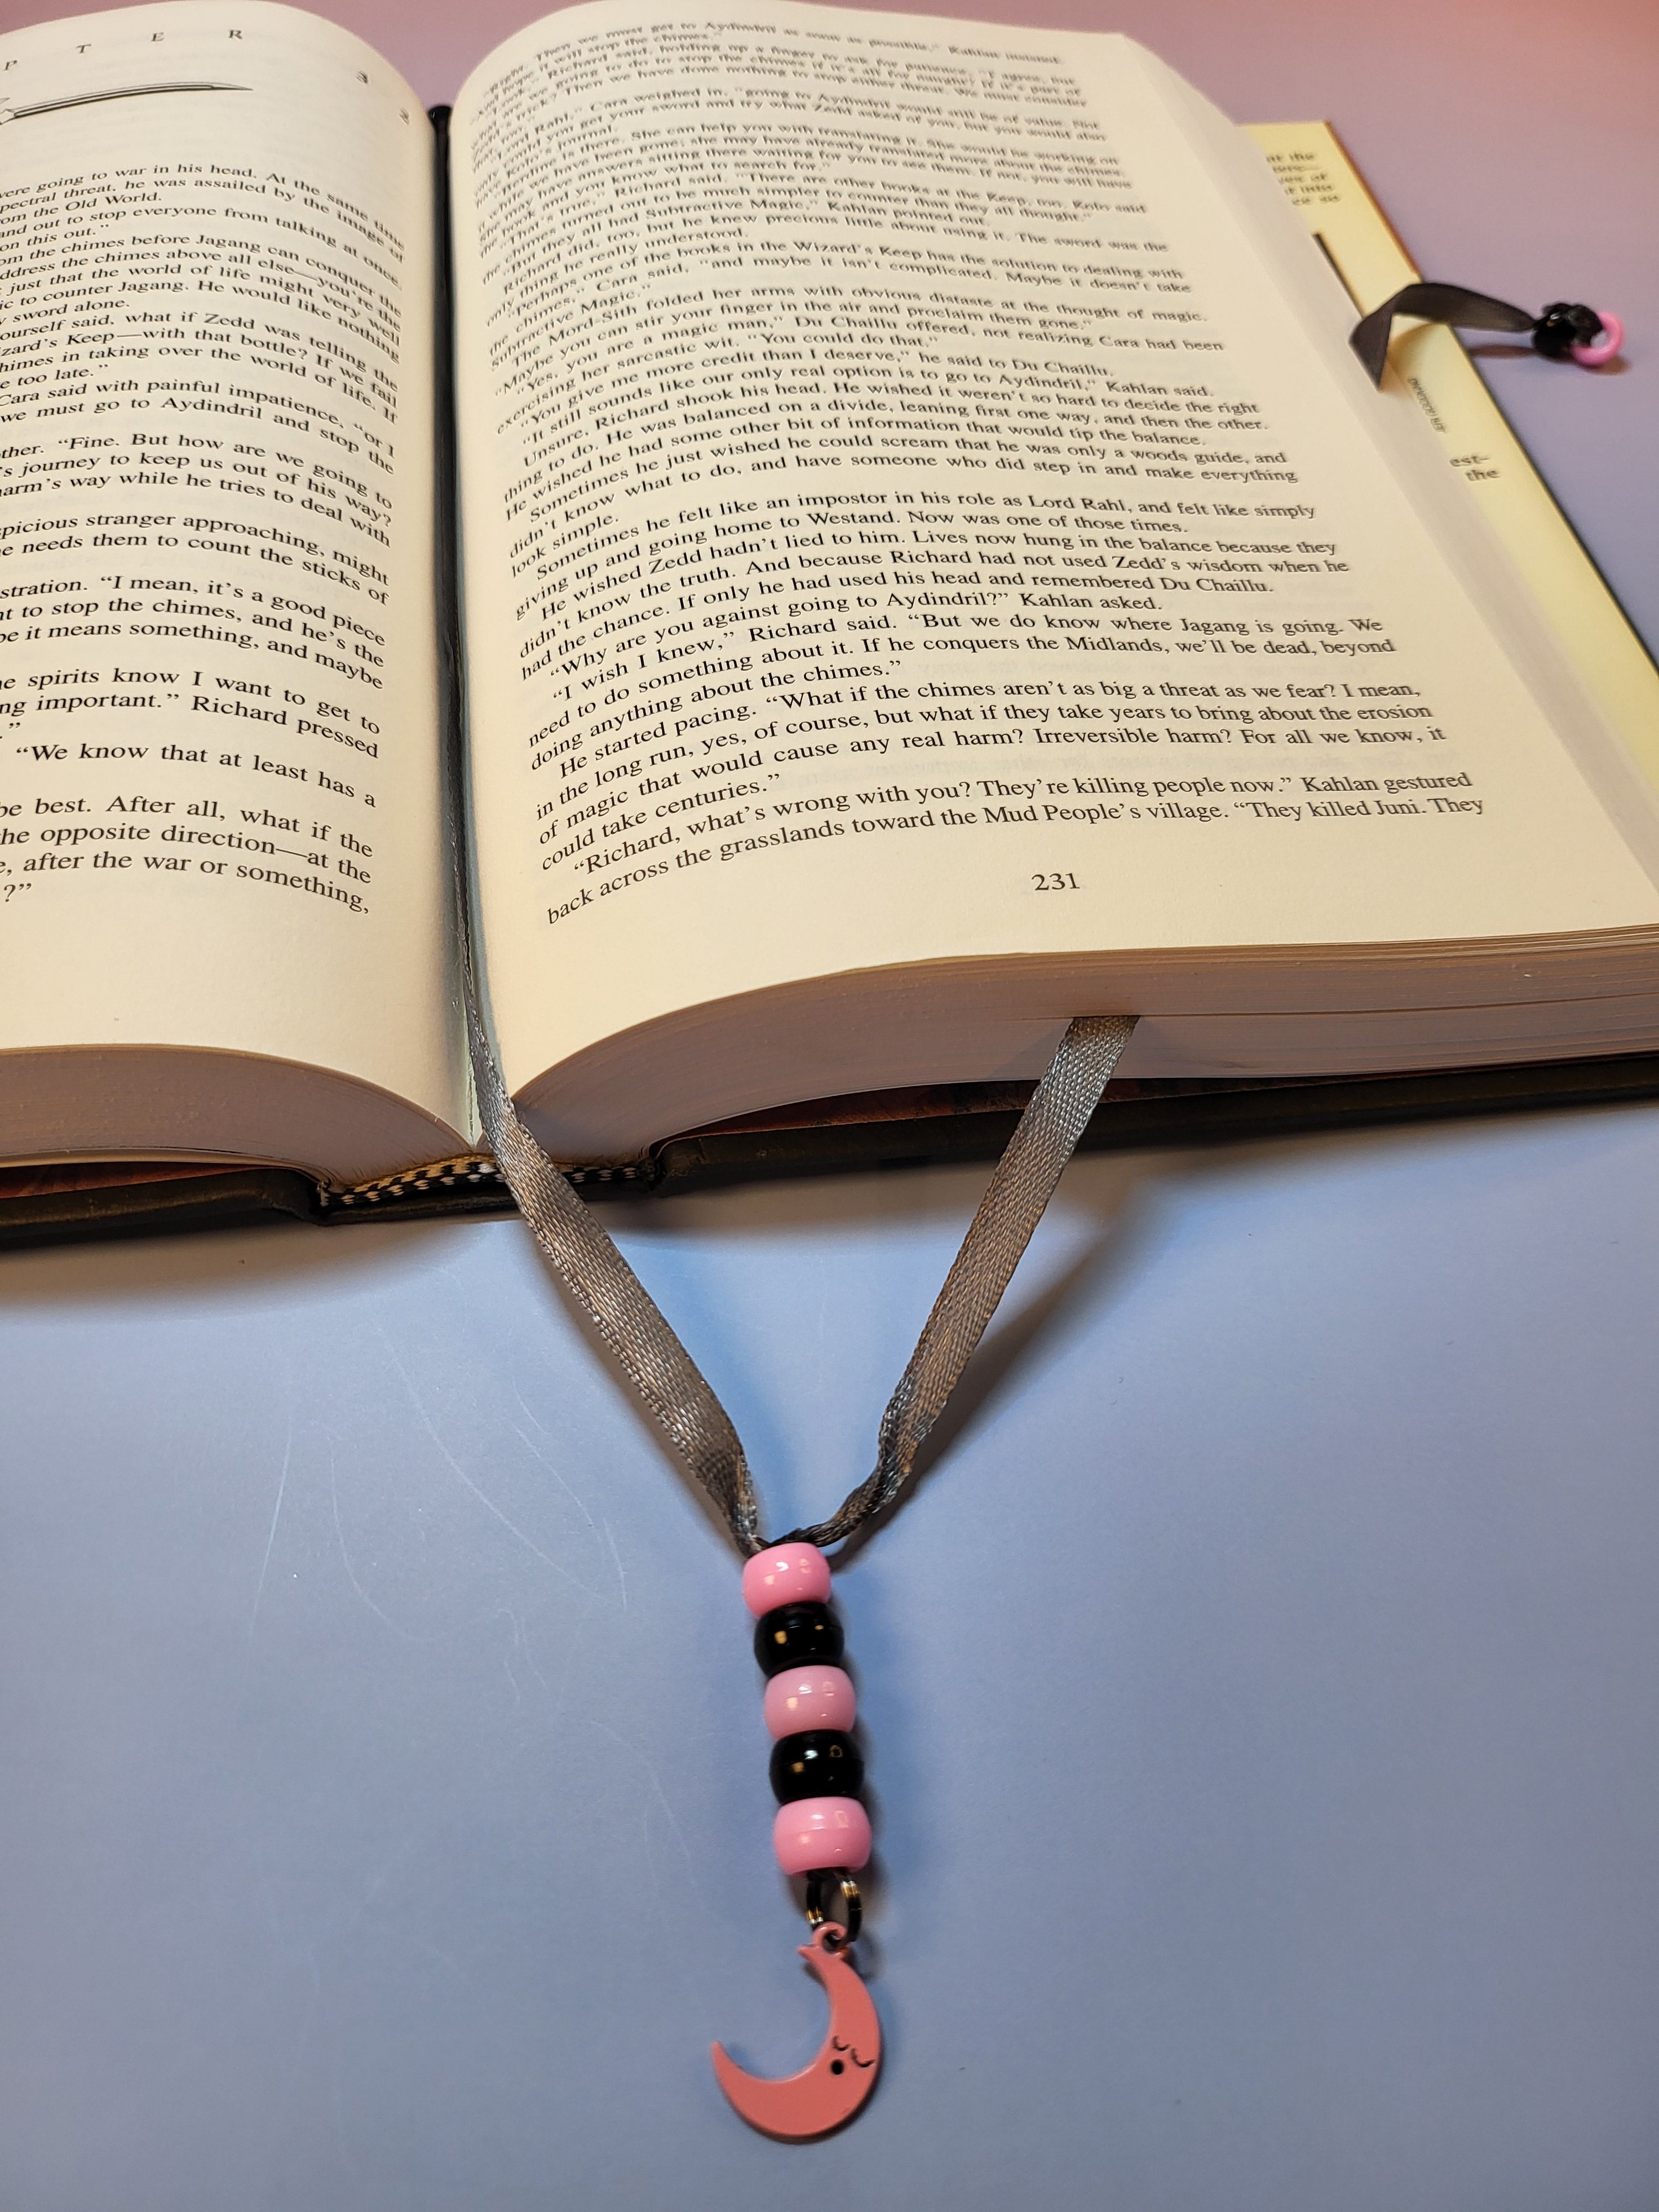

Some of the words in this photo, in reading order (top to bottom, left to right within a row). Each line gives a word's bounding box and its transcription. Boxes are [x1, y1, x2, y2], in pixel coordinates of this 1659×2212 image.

[34, 207, 59, 218] the
[65, 197, 97, 211] Old
[105, 192, 162, 205] World.
[125, 312, 171, 323] what
[181, 311, 199, 322] if
[204, 312, 255, 330] Zedd
[264, 324, 300, 341] was
[309, 337, 367, 373] telling
[373, 369, 398, 392] the
[0, 411, 27, 423] we
[36, 403, 85, 418] must
[93, 401, 120, 414] go
[131, 399, 150, 409] to
[160, 397, 262, 420] Aydindril
[273, 414, 310, 432] and
[320, 429, 359, 454] stop
[368, 451, 394, 474] the
[524, 430, 589, 467] Unsure,
[594, 399, 669, 431] Richard
[676, 389, 734, 409] shook
[740, 385, 769, 398] his
[774, 382, 827, 395] head.
[833, 382, 861, 394] He
[867, 383, 932, 397] wished
[938, 385, 952, 398] it
[1031, 394, 1051, 404] so
[1056, 393, 1097, 406] hard
[1101, 398, 1119, 408] to
[1124, 398, 1181, 412] decide
[1185, 401, 1213, 413] the
[1217, 402, 1260, 416] right
[22, 535, 83, 554] needs
[92, 533, 148, 547] them
[158, 535, 179, 547] to
[187, 539, 252, 556] count
[260, 547, 294, 566] the
[302, 561, 361, 591] sticks
[368, 588, 390, 606] of
[521, 649, 552, 681] had
[557, 635, 587, 656] the
[593, 607, 670, 638] chance.
[677, 593, 696, 611] If
[703, 585, 750, 604] only
[757, 581, 785, 595] he
[790, 574, 832, 591] had
[837, 571, 888, 587] used
[893, 571, 925, 585] his
[930, 570, 982, 585] head
[988, 572, 1026, 586] and
[1030, 575, 1156, 589] remembered
[1157, 577, 1192, 591] Du
[1196, 578, 1274, 592] Chaillu.
[531, 732, 583, 770] doing
[590, 696, 683, 737] anything
[691, 678, 754, 703] about
[760, 672, 796, 688] the
[77, 743, 150, 759] know
[161, 744, 208, 763] that
[218, 754, 242, 768] at
[252, 754, 309, 782] least
[317, 770, 354, 797] has
[364, 794, 376, 808] a
[536, 801, 554, 821] in
[559, 782, 589, 805] the
[594, 759, 643, 787] long
[648, 746, 693, 766] run,
[700, 733, 747, 756] yes,
[754, 721, 778, 739] of
[786, 716, 869, 734] course,
[873, 709, 914, 724] but
[918, 706, 975, 722] what
[979, 705, 998, 720] if
[1003, 704, 1050, 723] they
[1057, 704, 1104, 719] take
[1108, 708, 1166, 723] years
[1170, 706, 1192, 719] to
[1194, 705, 1255, 724] bring
[1258, 706, 1317, 721] about
[1318, 706, 1352, 721] the
[1357, 704, 1434, 720] erosion
[23, 852, 85, 872] after
[93, 851, 133, 868] the
[143, 857, 192, 872] war
[200, 860, 228, 875] or
[236, 865, 369, 914] something,
[547, 888, 595, 925] back
[600, 861, 669, 896] across
[675, 849, 712, 868] the
[719, 820, 845, 862] grasslands
[851, 810, 936, 833] toward
[940, 808, 978, 826] the
[980, 805, 1039, 823] Mud
[1145, 802, 1229, 822] village.
[1305, 800, 1373, 817] killed
[1373, 799, 1427, 815] Juni.
[1426, 797, 1483, 815] They
[1031, 872, 1081, 891] 231
